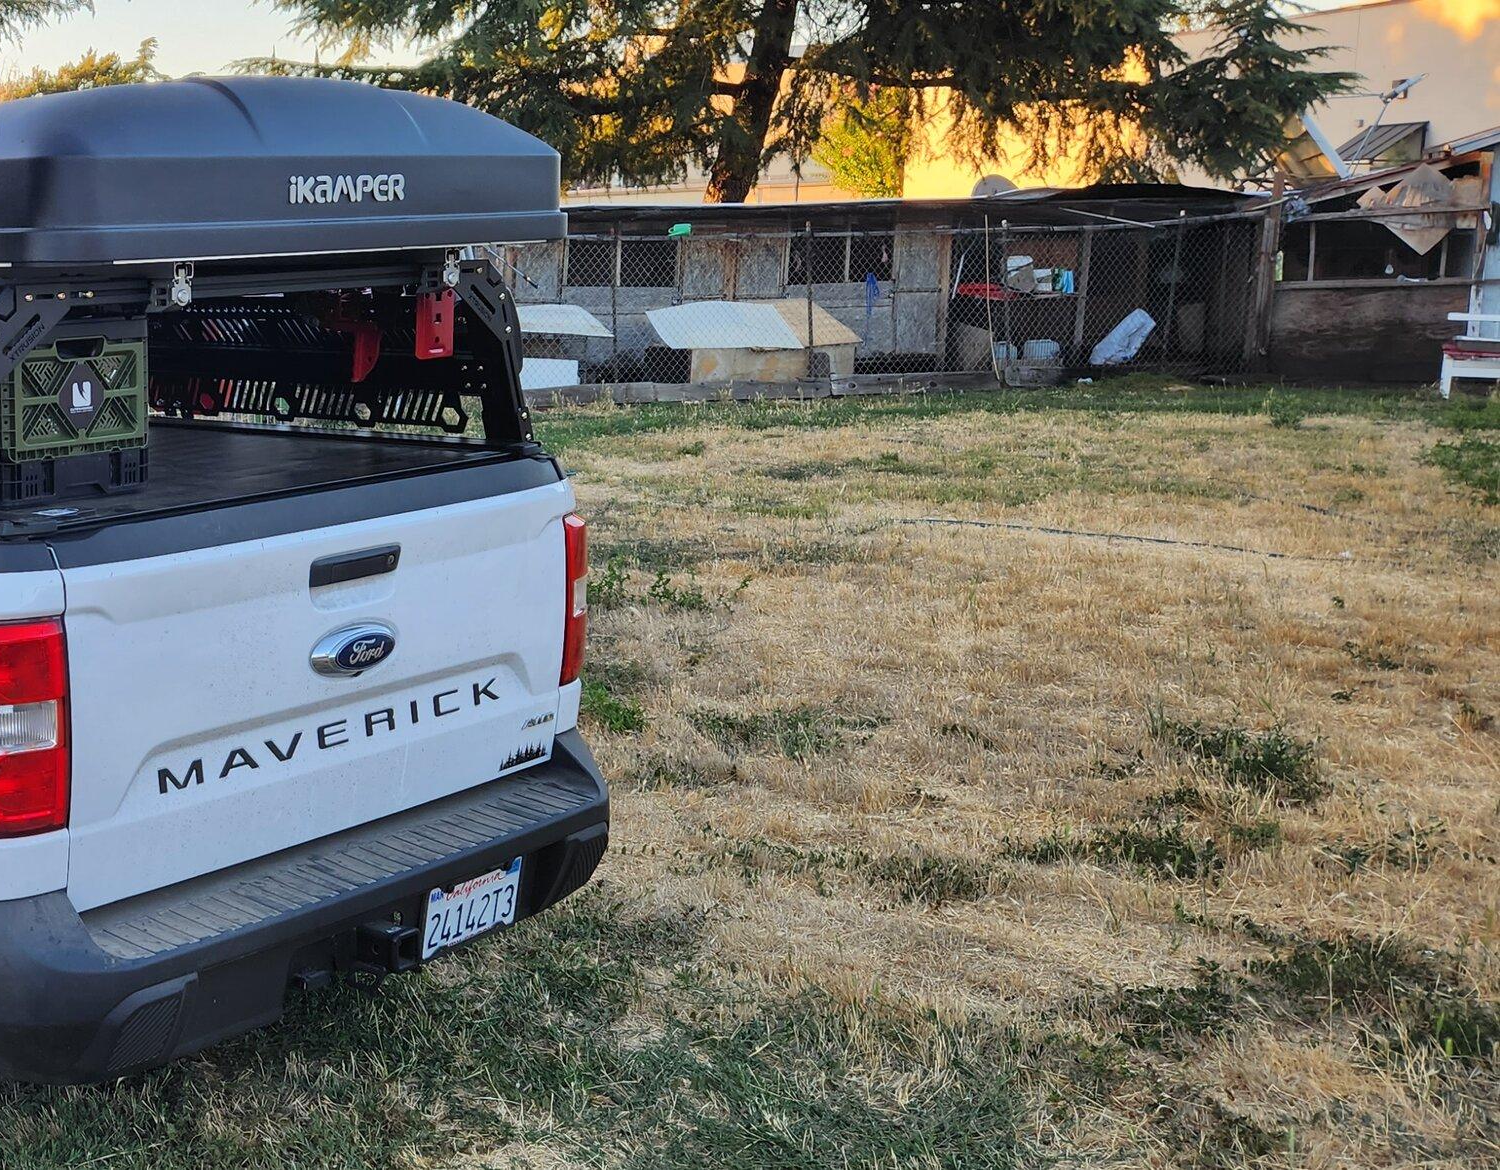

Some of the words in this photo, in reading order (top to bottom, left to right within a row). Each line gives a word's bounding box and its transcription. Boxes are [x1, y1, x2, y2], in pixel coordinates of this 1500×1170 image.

[8, 322, 45, 361] XTRUSION
[349, 638, 385, 665] Ford
[156, 677, 501, 795] MAVERICK
[446, 871, 504, 901] California
[427, 884, 515, 950] 24142T3
